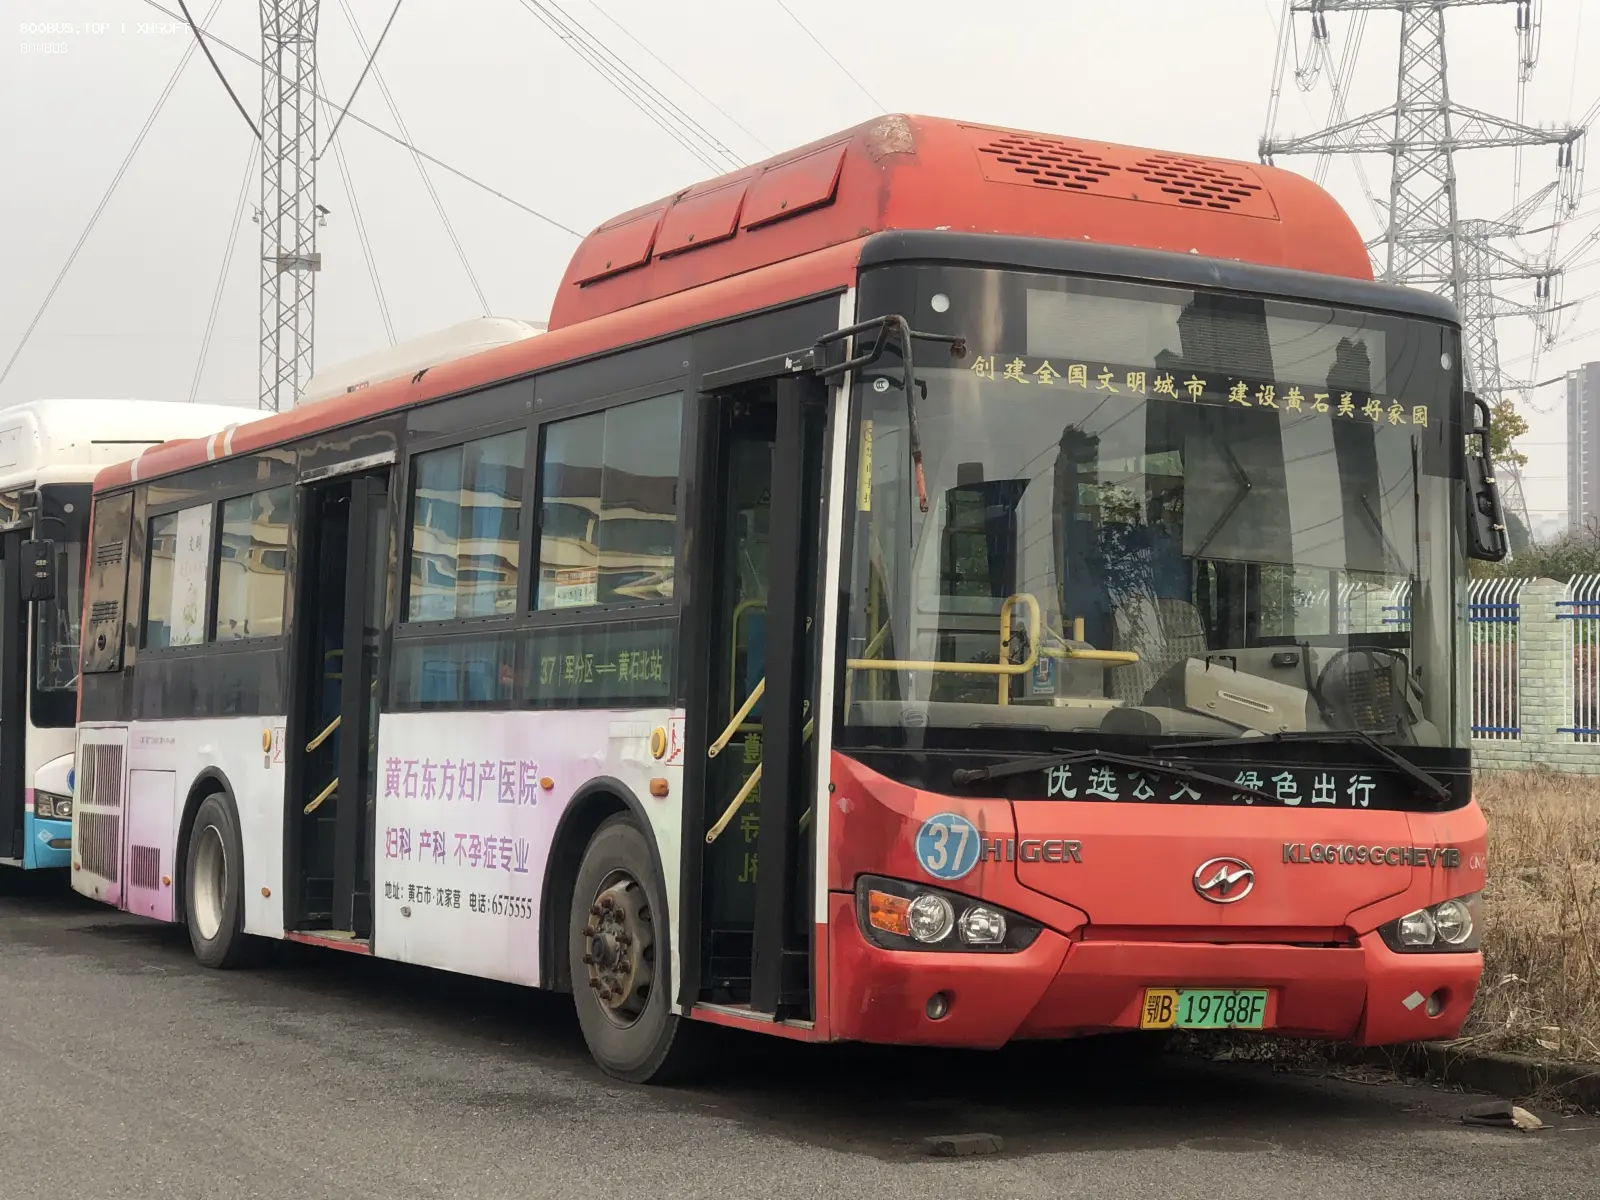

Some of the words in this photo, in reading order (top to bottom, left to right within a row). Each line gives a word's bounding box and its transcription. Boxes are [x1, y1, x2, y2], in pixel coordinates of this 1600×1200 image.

[970, 355, 1207, 403] 创建全国文明城市
[1228, 380, 1429, 428] 建设黄石美好家园
[540, 656, 556, 685] 37
[618, 649, 662, 682] 黄石北站
[385, 757, 538, 805] 黄石东方妇产医院
[385, 827, 411, 861] 妇科
[418, 830, 446, 865] 产科
[454, 833, 529, 873] 不孕症专业
[927, 823, 969, 871] 37
[981, 838, 1083, 863] HIGER
[1282, 843, 1460, 868] KLQ6109GCHEV1B
[1184, 995, 1264, 1023] 19788F
